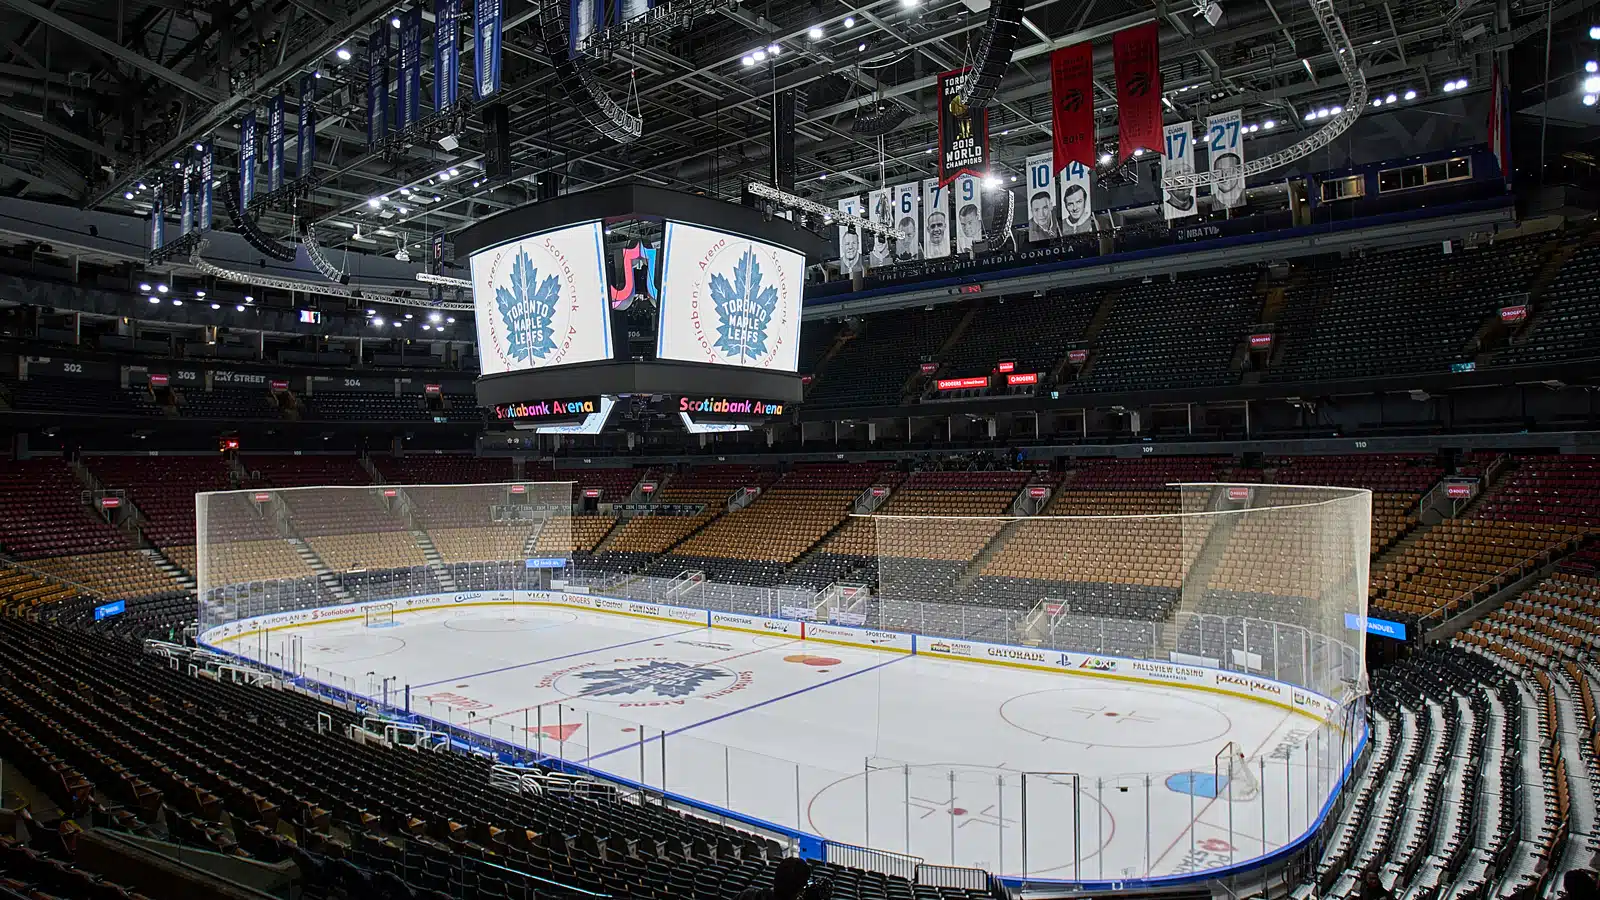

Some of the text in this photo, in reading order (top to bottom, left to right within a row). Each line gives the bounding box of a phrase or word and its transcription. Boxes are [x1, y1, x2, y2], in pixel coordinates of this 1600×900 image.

[1211, 121, 1240, 151] 27
[953, 138, 974, 151] 2019
[1166, 132, 1187, 160] 17
[946, 146, 982, 162] WORLD
[1028, 157, 1052, 167] ARMSTRONG
[946, 157, 982, 169] CHAMPIONS
[1066, 161, 1084, 181] 14
[1032, 165, 1049, 189] 10
[930, 187, 940, 209] 7
[962, 179, 973, 201] 9
[901, 193, 911, 213] 6
[1187, 227, 1203, 238] NBA
[982, 255, 1014, 265] MEDIA
[1021, 246, 1074, 260] GONDOLA
[507, 299, 549, 323] TORONTO
[722, 298, 767, 322] TORONTO
[514, 316, 542, 332] MAPLE
[729, 314, 759, 331] MAPLE
[728, 328, 758, 343] LEAFS
[63, 363, 82, 373] 302
[178, 371, 196, 380] 303
[233, 374, 266, 384] STREET
[344, 379, 361, 387] 304
[496, 398, 594, 419] Scotiabank Arena
[680, 398, 783, 416] Scotiabank Arena
[568, 596, 591, 605] ROGERS
[602, 600, 623, 609] Castrol
[262, 614, 300, 625] AEROPLAN
[320, 606, 356, 617] Scotiabank
[720, 615, 752, 625] POKERSTARS
[987, 647, 1045, 662] GATORADE
[1133, 662, 1204, 678] FALLSVIEW CASINO
[1216, 674, 1281, 695] pizza pizza
